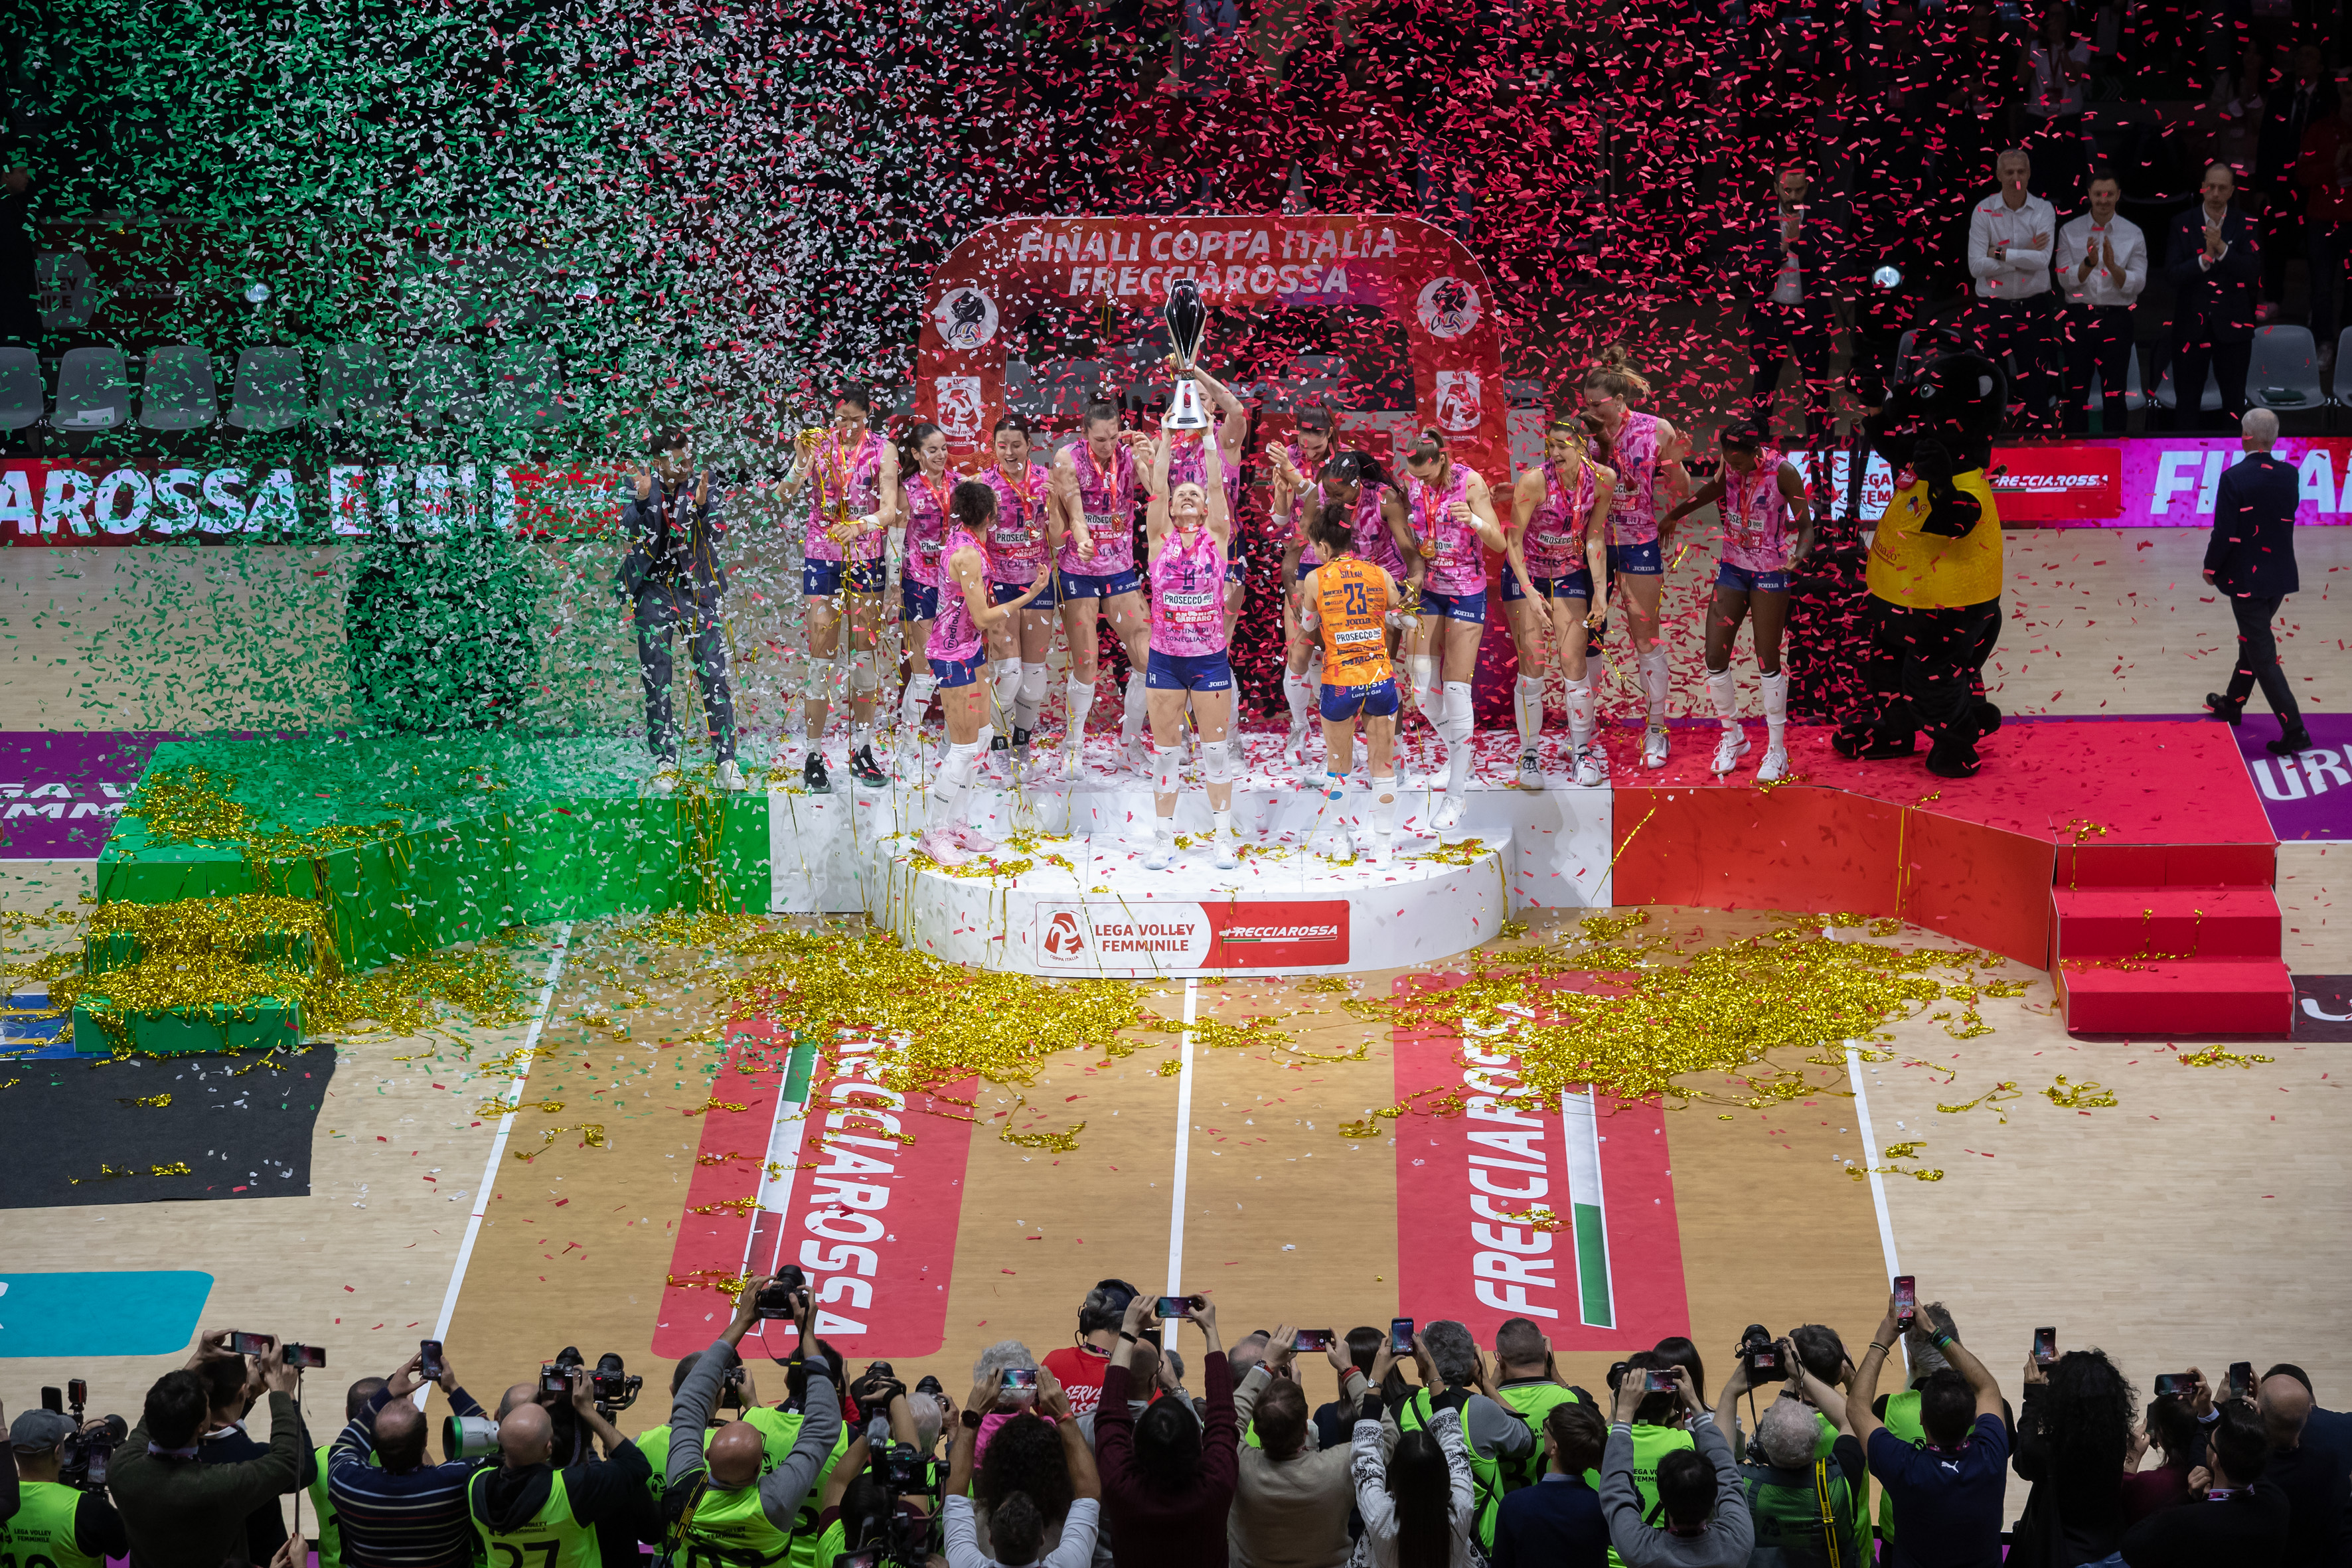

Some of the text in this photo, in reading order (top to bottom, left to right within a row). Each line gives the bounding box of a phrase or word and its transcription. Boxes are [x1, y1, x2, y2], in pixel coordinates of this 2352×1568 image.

[1019, 229, 1398, 262] FINALI COPPA ITALIA
[1994, 475, 2108, 487] RECCIAROSS
[1084, 514, 1112, 523] PROSECC
[996, 533, 1029, 542] PROSEC
[1184, 568, 1196, 586] 14
[1164, 595, 1202, 605] PROSECCO
[1343, 582, 1368, 615] 23
[1453, 609, 1475, 618] Joma
[1345, 617, 1372, 627] Joma
[1336, 631, 1373, 643] PROSECCO
[1148, 672, 1156, 684] 14
[1095, 923, 1196, 936] LEGA VOLLEY
[1102, 939, 1189, 952] FEMMINILE
